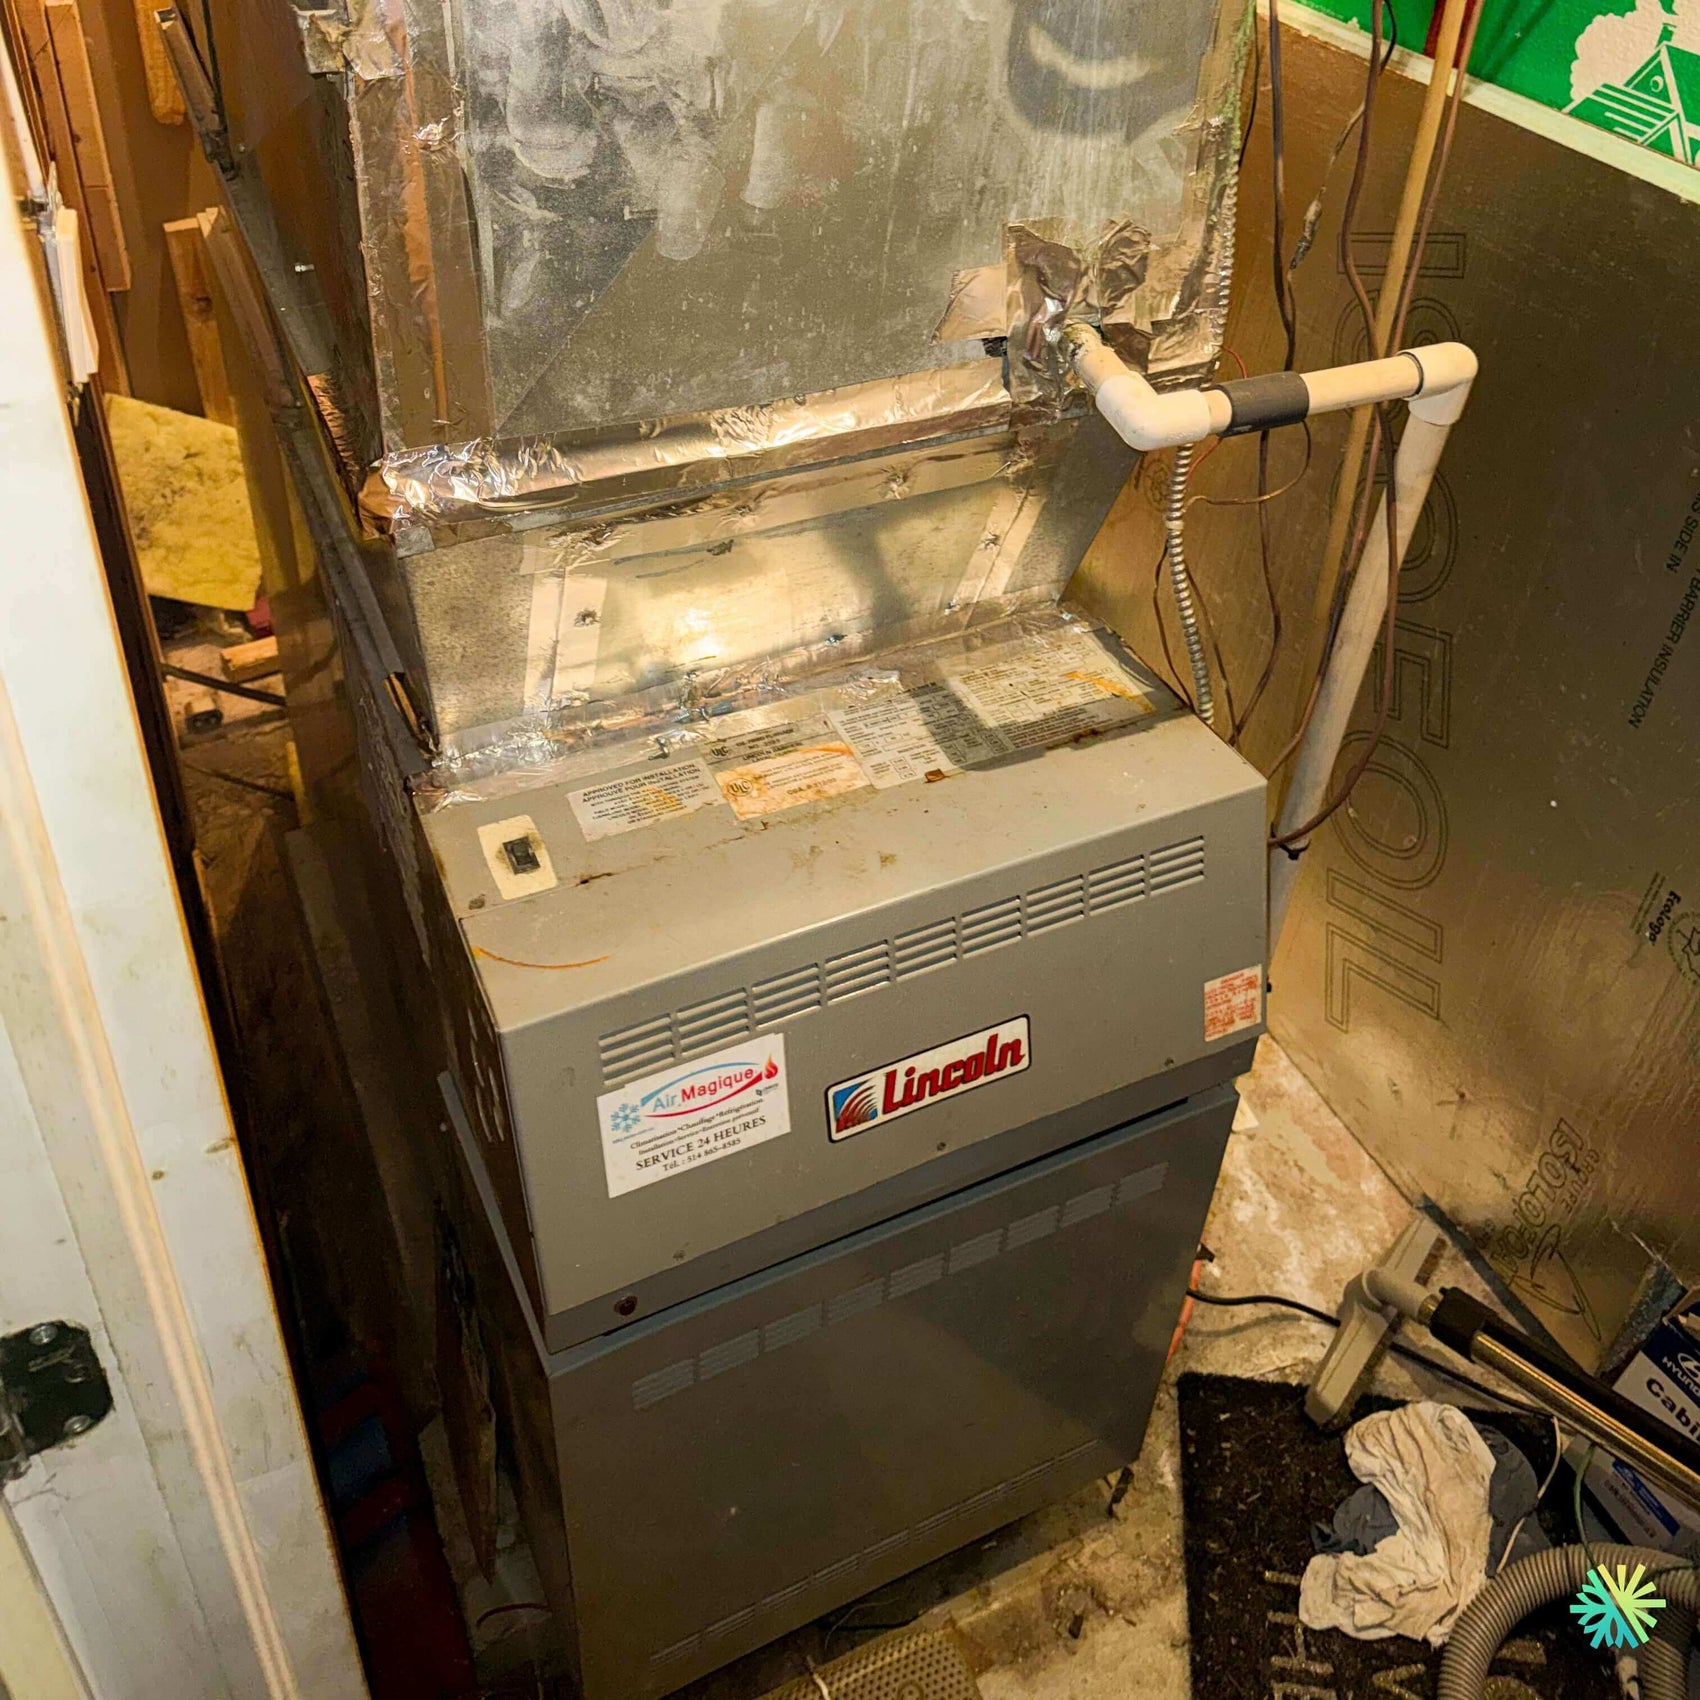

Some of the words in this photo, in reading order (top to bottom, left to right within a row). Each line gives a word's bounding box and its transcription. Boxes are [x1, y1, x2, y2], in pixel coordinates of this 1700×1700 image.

[1674, 515, 1698, 554] SIDE
[1666, 553, 1682, 574] IN
[1666, 577, 1700, 645] BARRIER
[1628, 643, 1674, 729] INSULATION
[582, 782, 624, 797] APPROVED
[625, 777, 642, 786] FOR
[642, 763, 696, 780] INSTALLATION
[625, 782, 647, 791] POUR
[729, 780, 751, 796] ULC
[652, 1093, 677, 1113] Air
[681, 1067, 754, 1103] Magique
[882, 1032, 1035, 1115] Lincoln
[636, 1141, 696, 1170] SERVICE
[696, 1136, 710, 1149] 24
[713, 1115, 767, 1142] HEURES
[687, 1153, 702, 1163] 514
[1490, 1117, 1584, 1285] ISOLOFOA
[1645, 1378, 1700, 1442] Cabi
